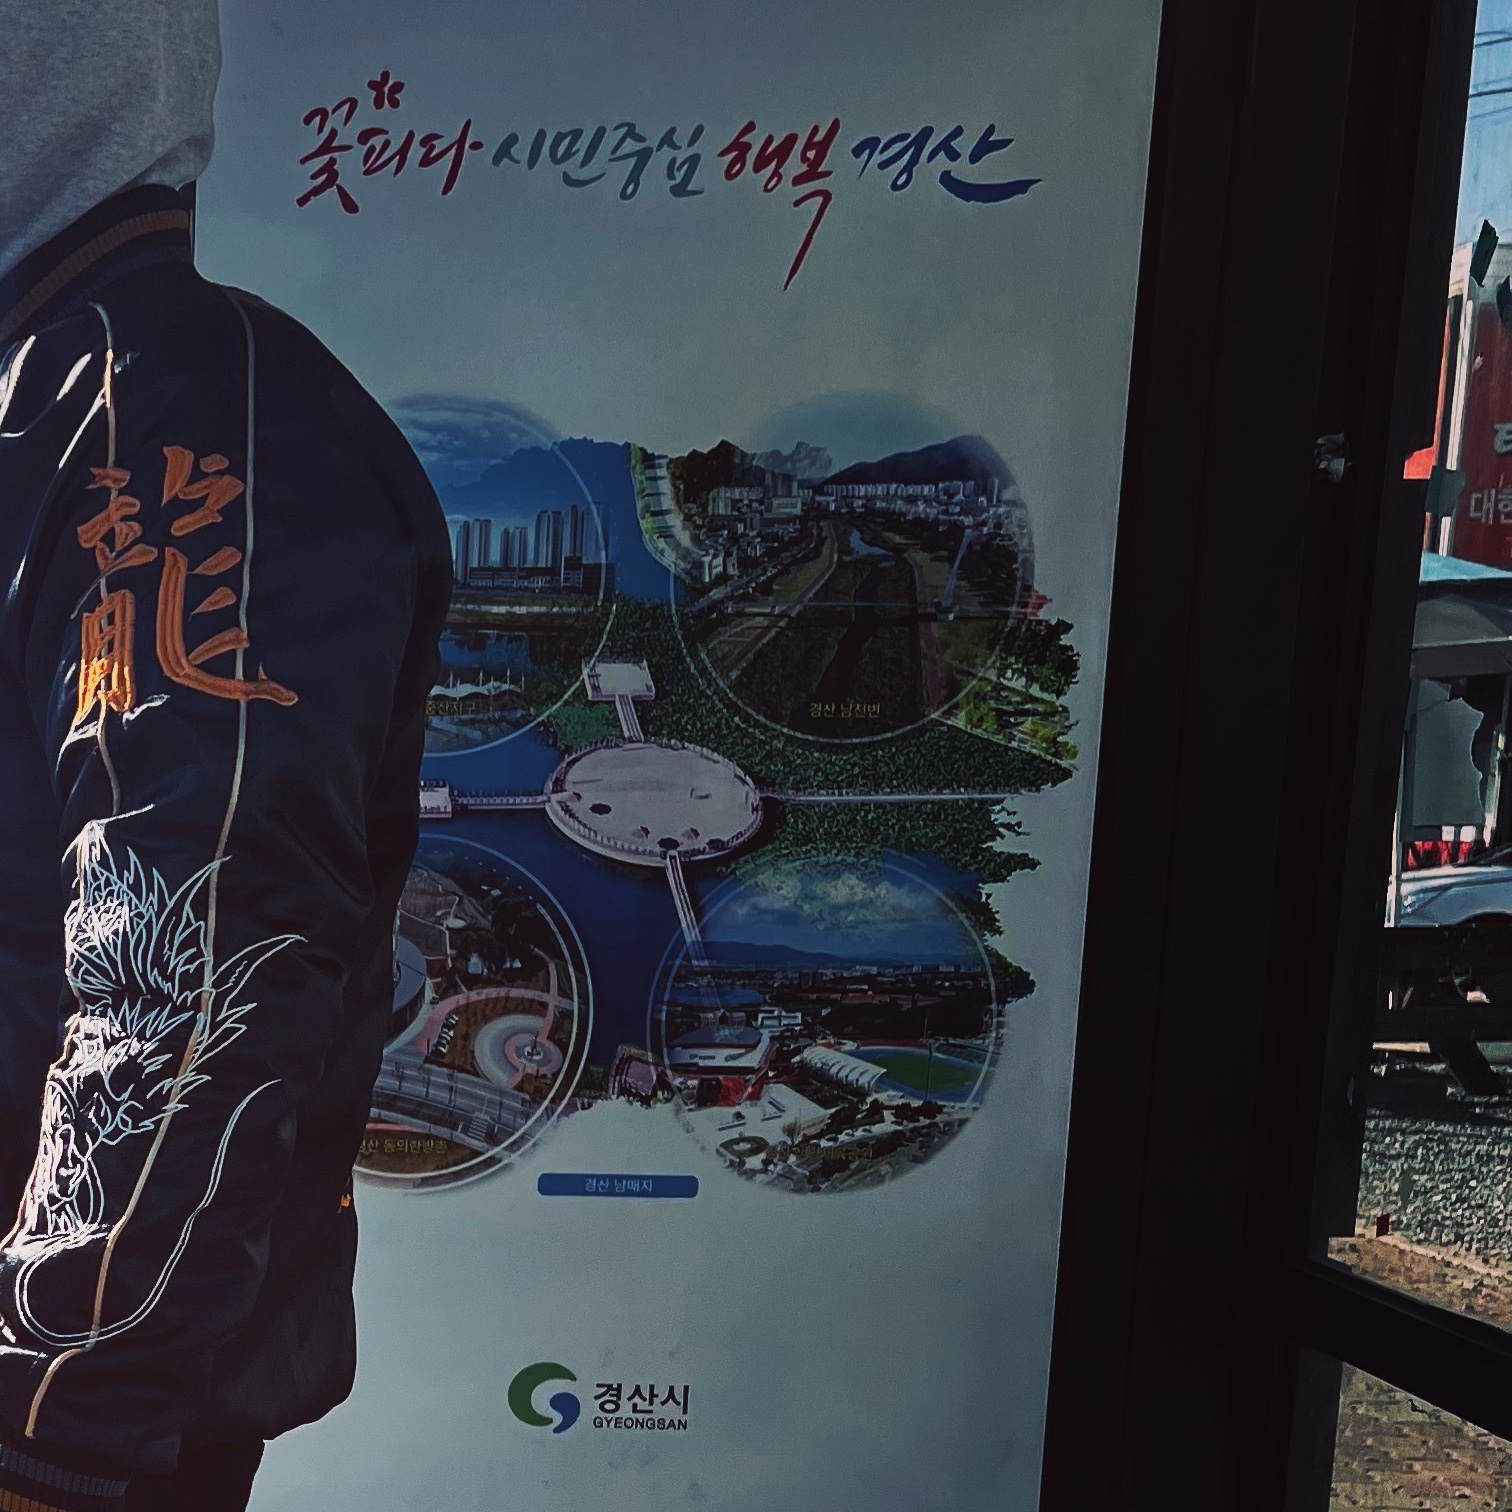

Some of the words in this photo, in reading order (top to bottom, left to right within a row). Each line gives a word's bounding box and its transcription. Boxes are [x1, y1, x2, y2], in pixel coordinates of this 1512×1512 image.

[491, 120, 705, 200] 시민중심
[584, 1177, 610, 1193] 경산
[592, 1382, 689, 1415] 경산시
[592, 1416, 688, 1431] GYEONGSAN
